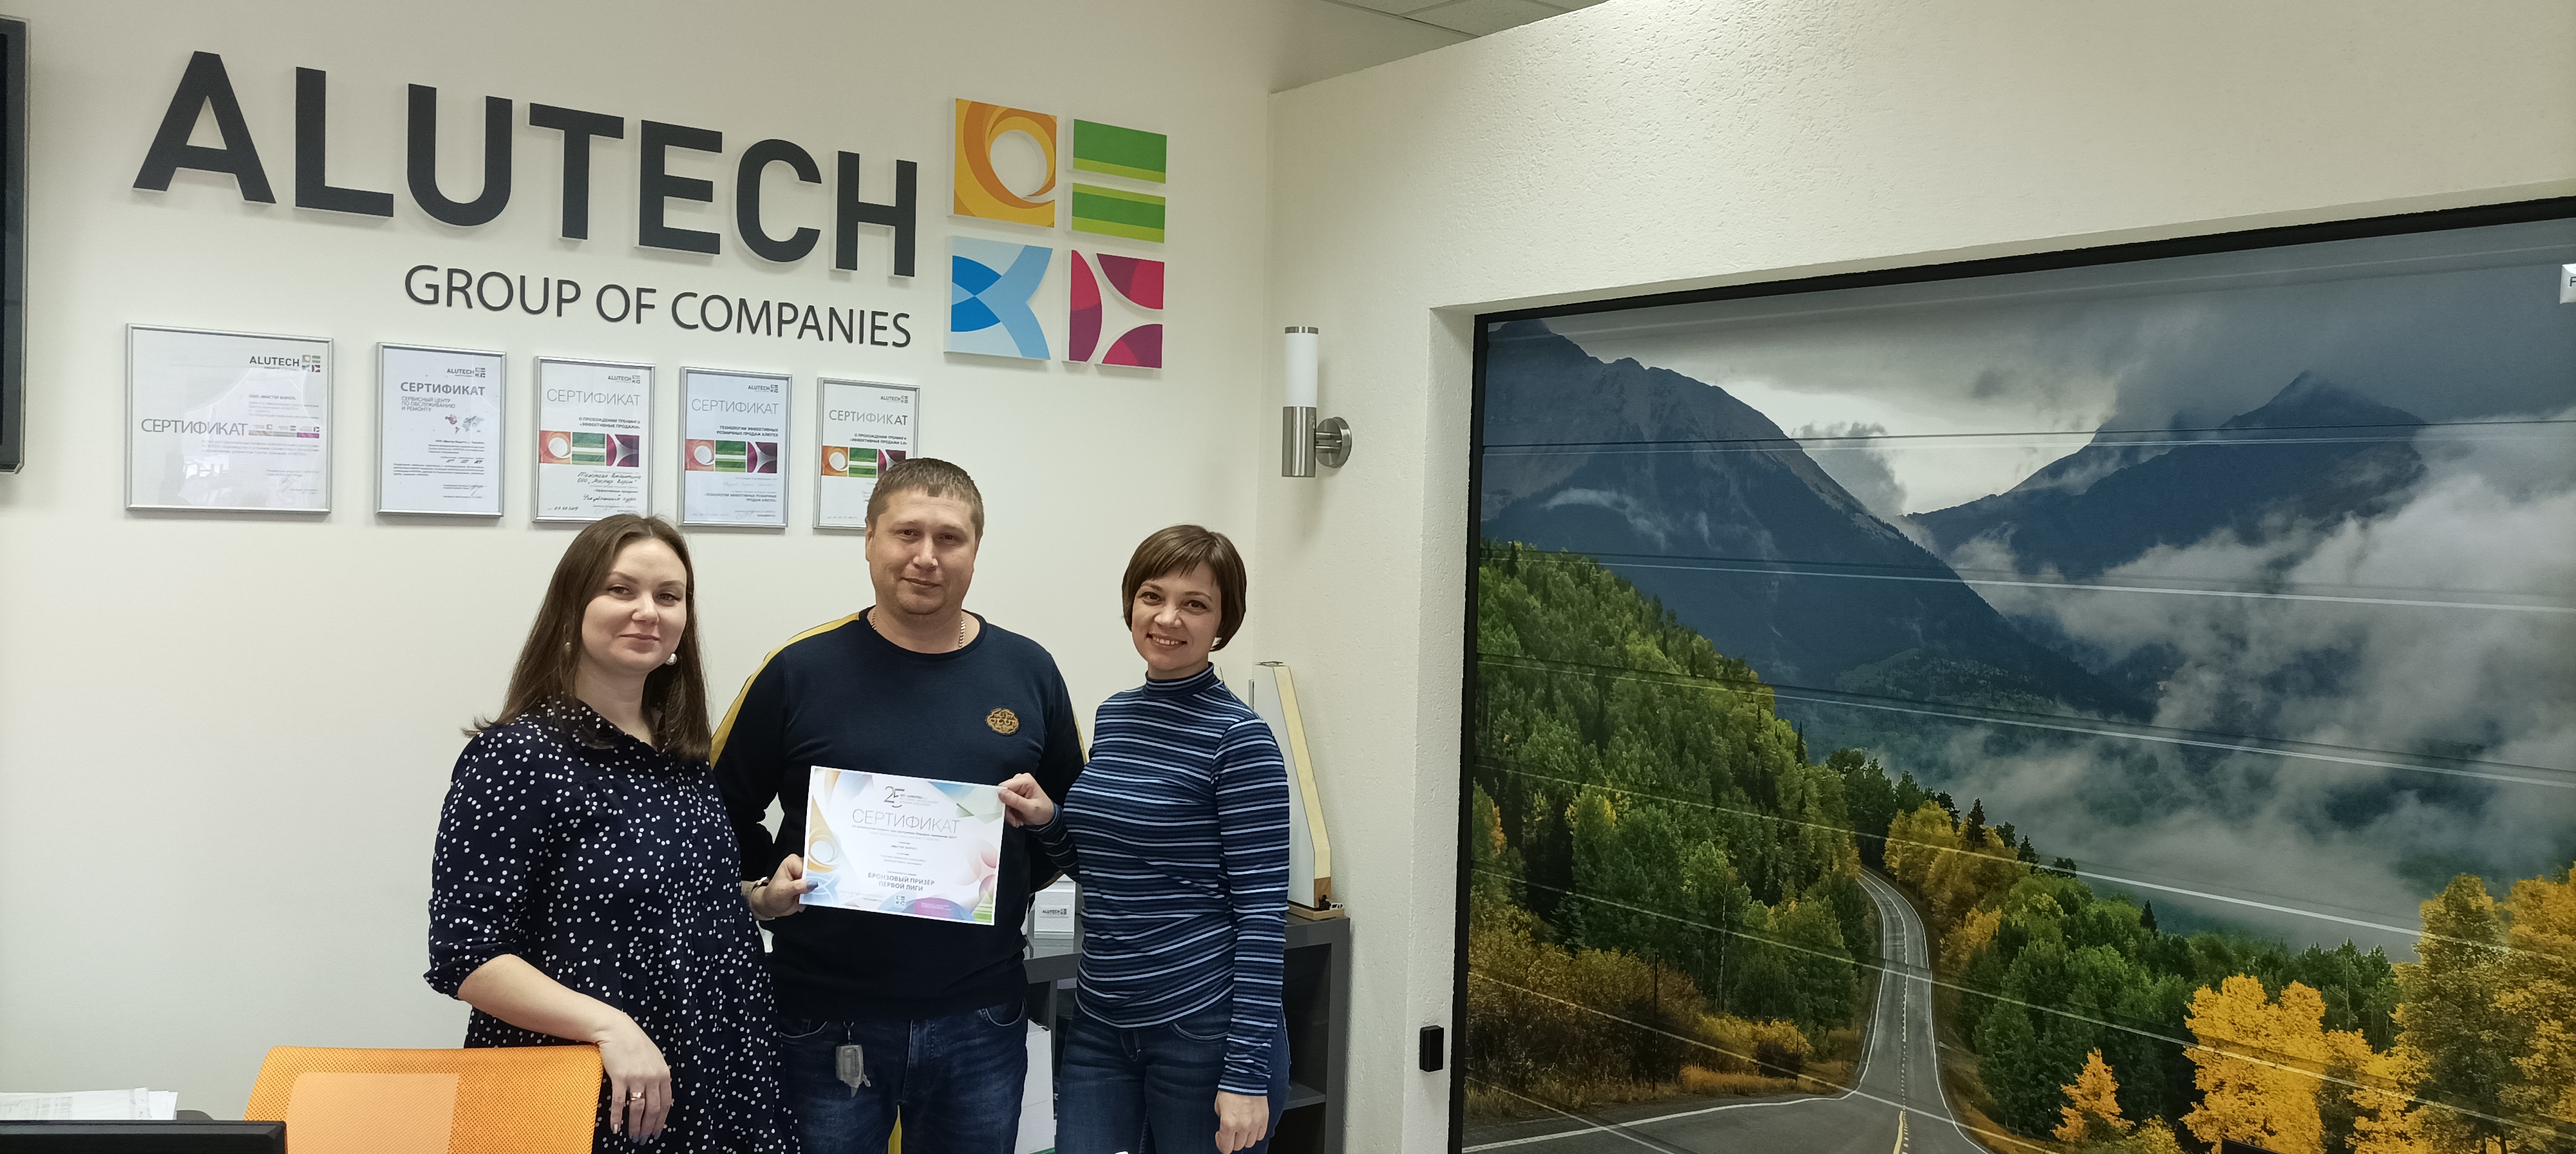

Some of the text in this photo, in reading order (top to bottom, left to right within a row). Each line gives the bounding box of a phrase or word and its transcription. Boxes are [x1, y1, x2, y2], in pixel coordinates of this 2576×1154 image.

[132, 50, 918, 278] ALUTECH
[405, 265, 912, 348] GROUP OF COMPANIES
[249, 355, 299, 367] ALUTECH
[401, 381, 485, 395] СЕРТИФИКАТ
[547, 388, 641, 406] СЕРТИФИКАТ
[692, 399, 779, 415] СЕРТИФИКАТ
[829, 410, 907, 426] СЕРТИФИКАТ
[141, 419, 248, 436] СЕРТИФИКАТ
[884, 786, 905, 808] 25
[853, 809, 960, 833] СЕРТИФИКАТ
[868, 872, 909, 883] БРОНЗОВЫЙ
[878, 881, 904, 889] ПЕРВОЙ
